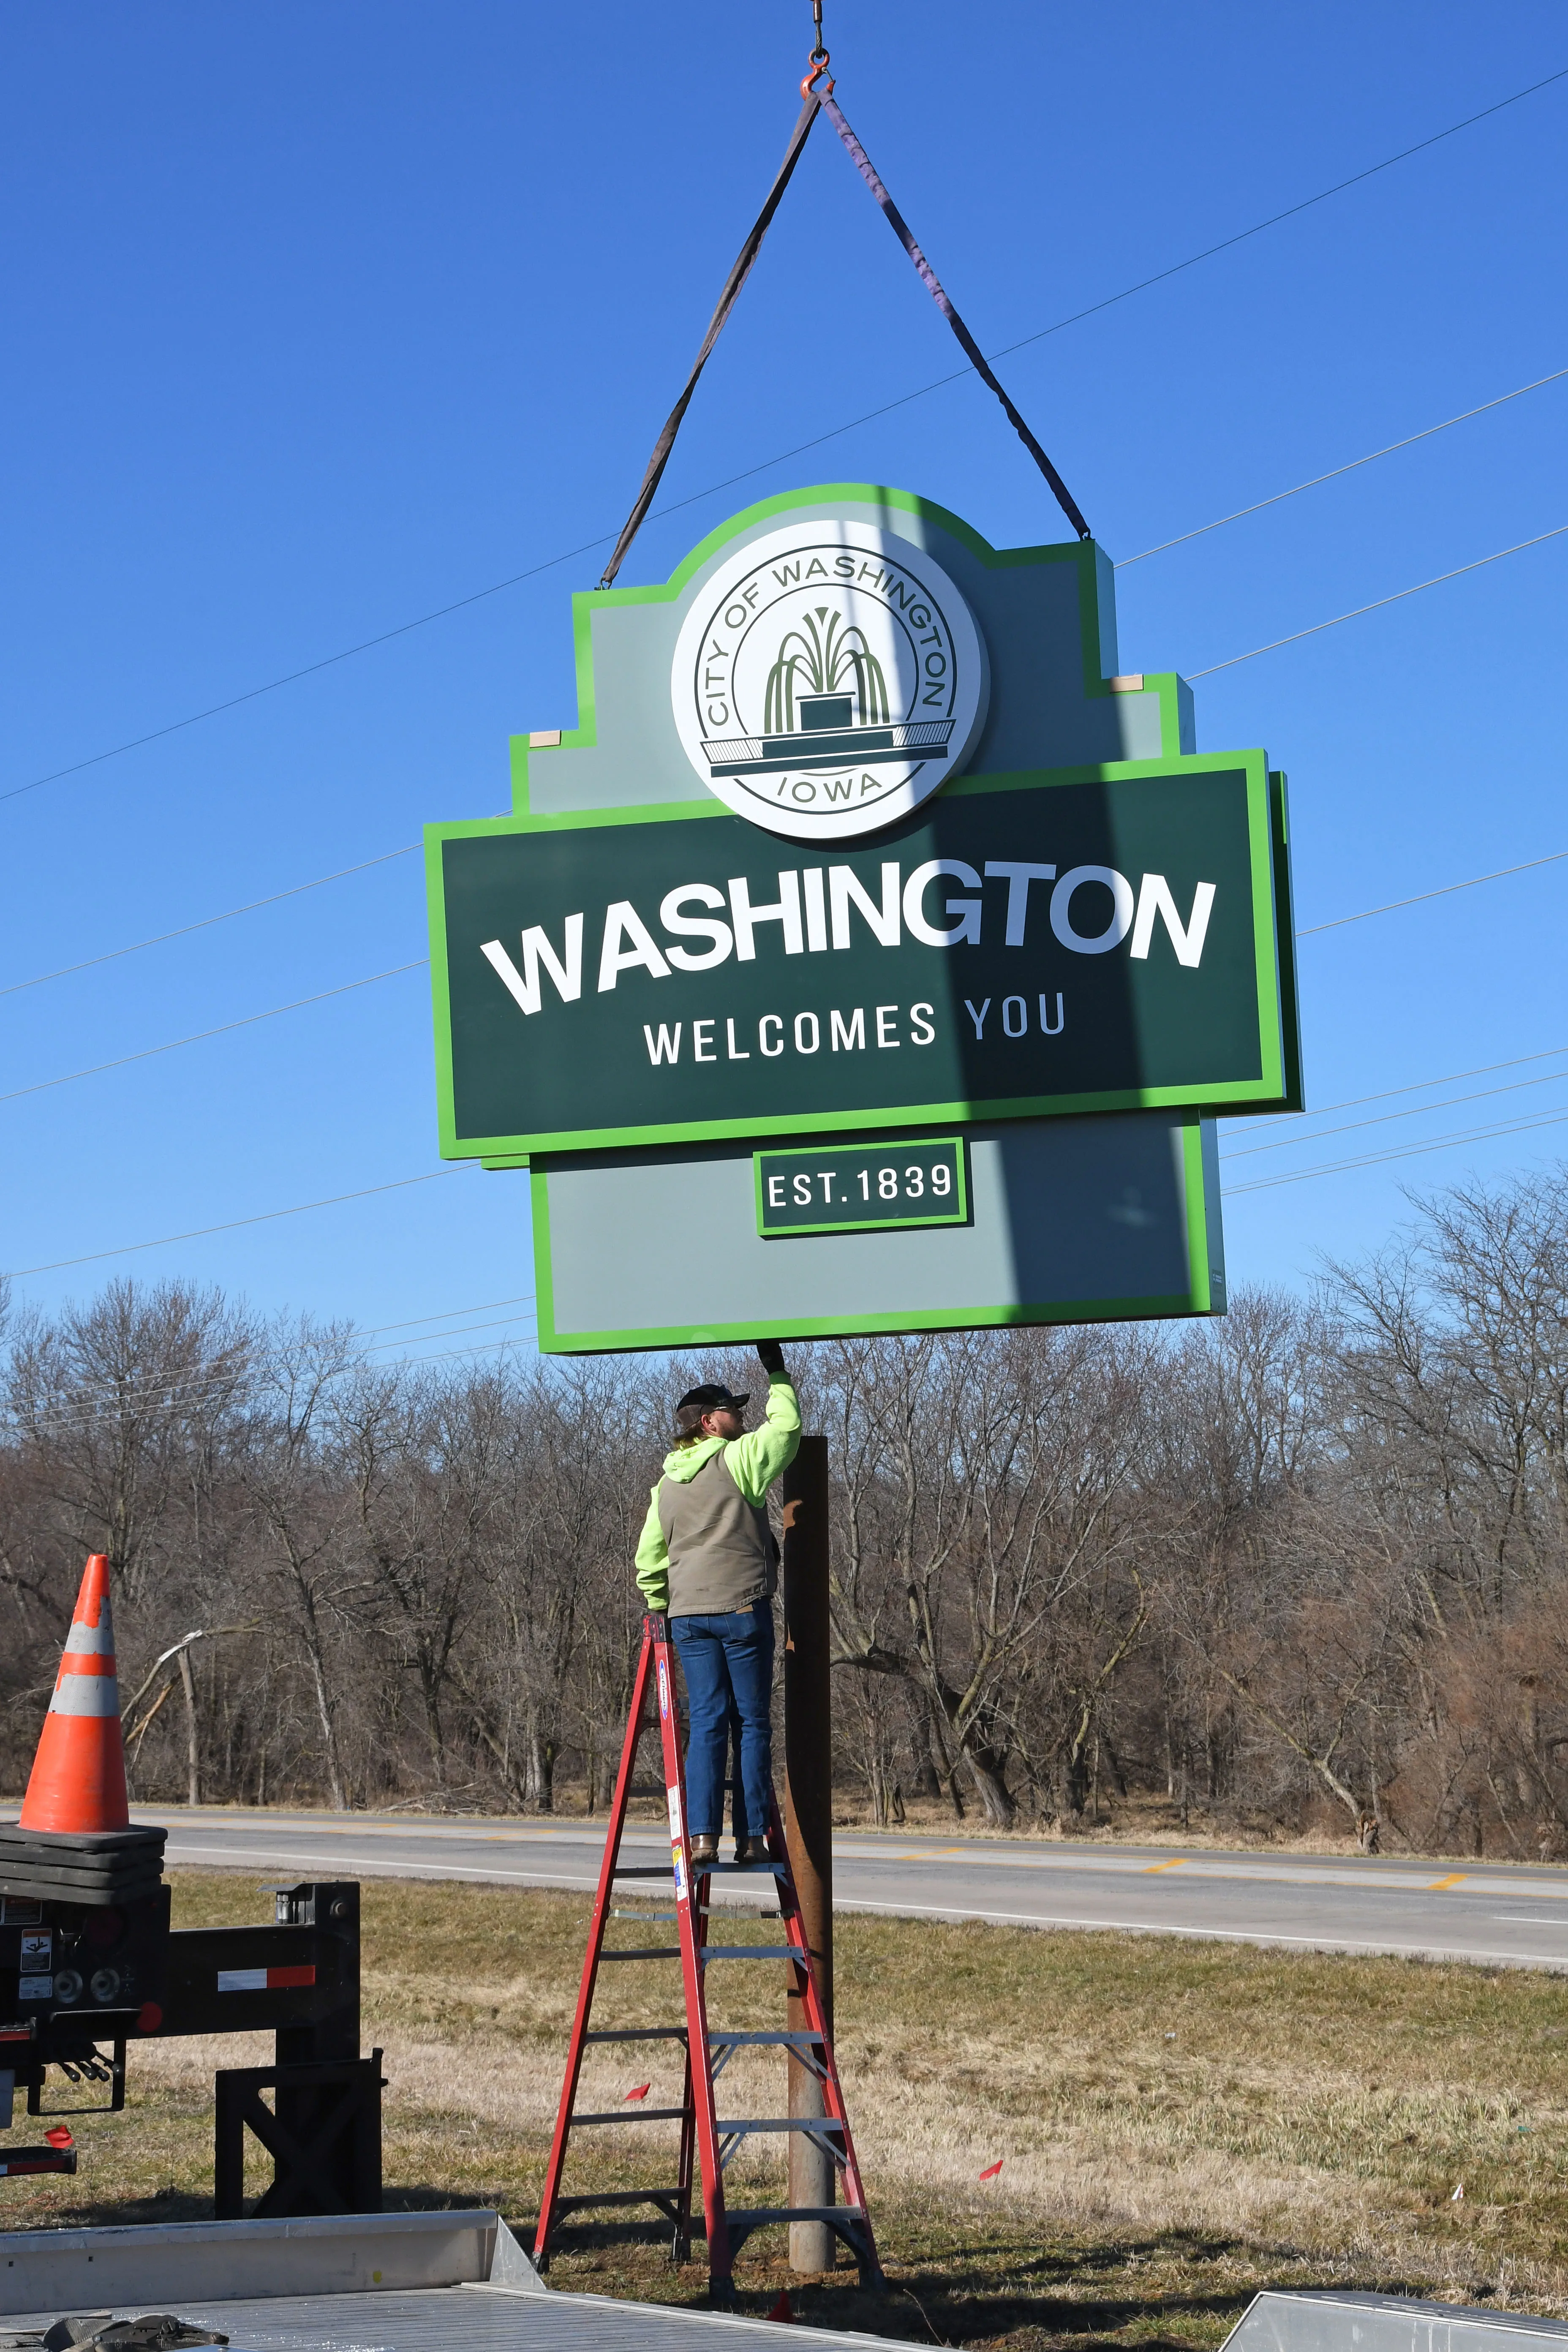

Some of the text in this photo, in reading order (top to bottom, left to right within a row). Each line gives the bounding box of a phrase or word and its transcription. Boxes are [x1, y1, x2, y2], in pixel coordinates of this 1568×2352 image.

[705, 555, 947, 726] CITY OF WASHINGTON
[777, 773, 883, 803] IOWA
[479, 859, 1217, 1015] WASHINGTON
[643, 992, 1064, 1065] WELCOMES YOU
